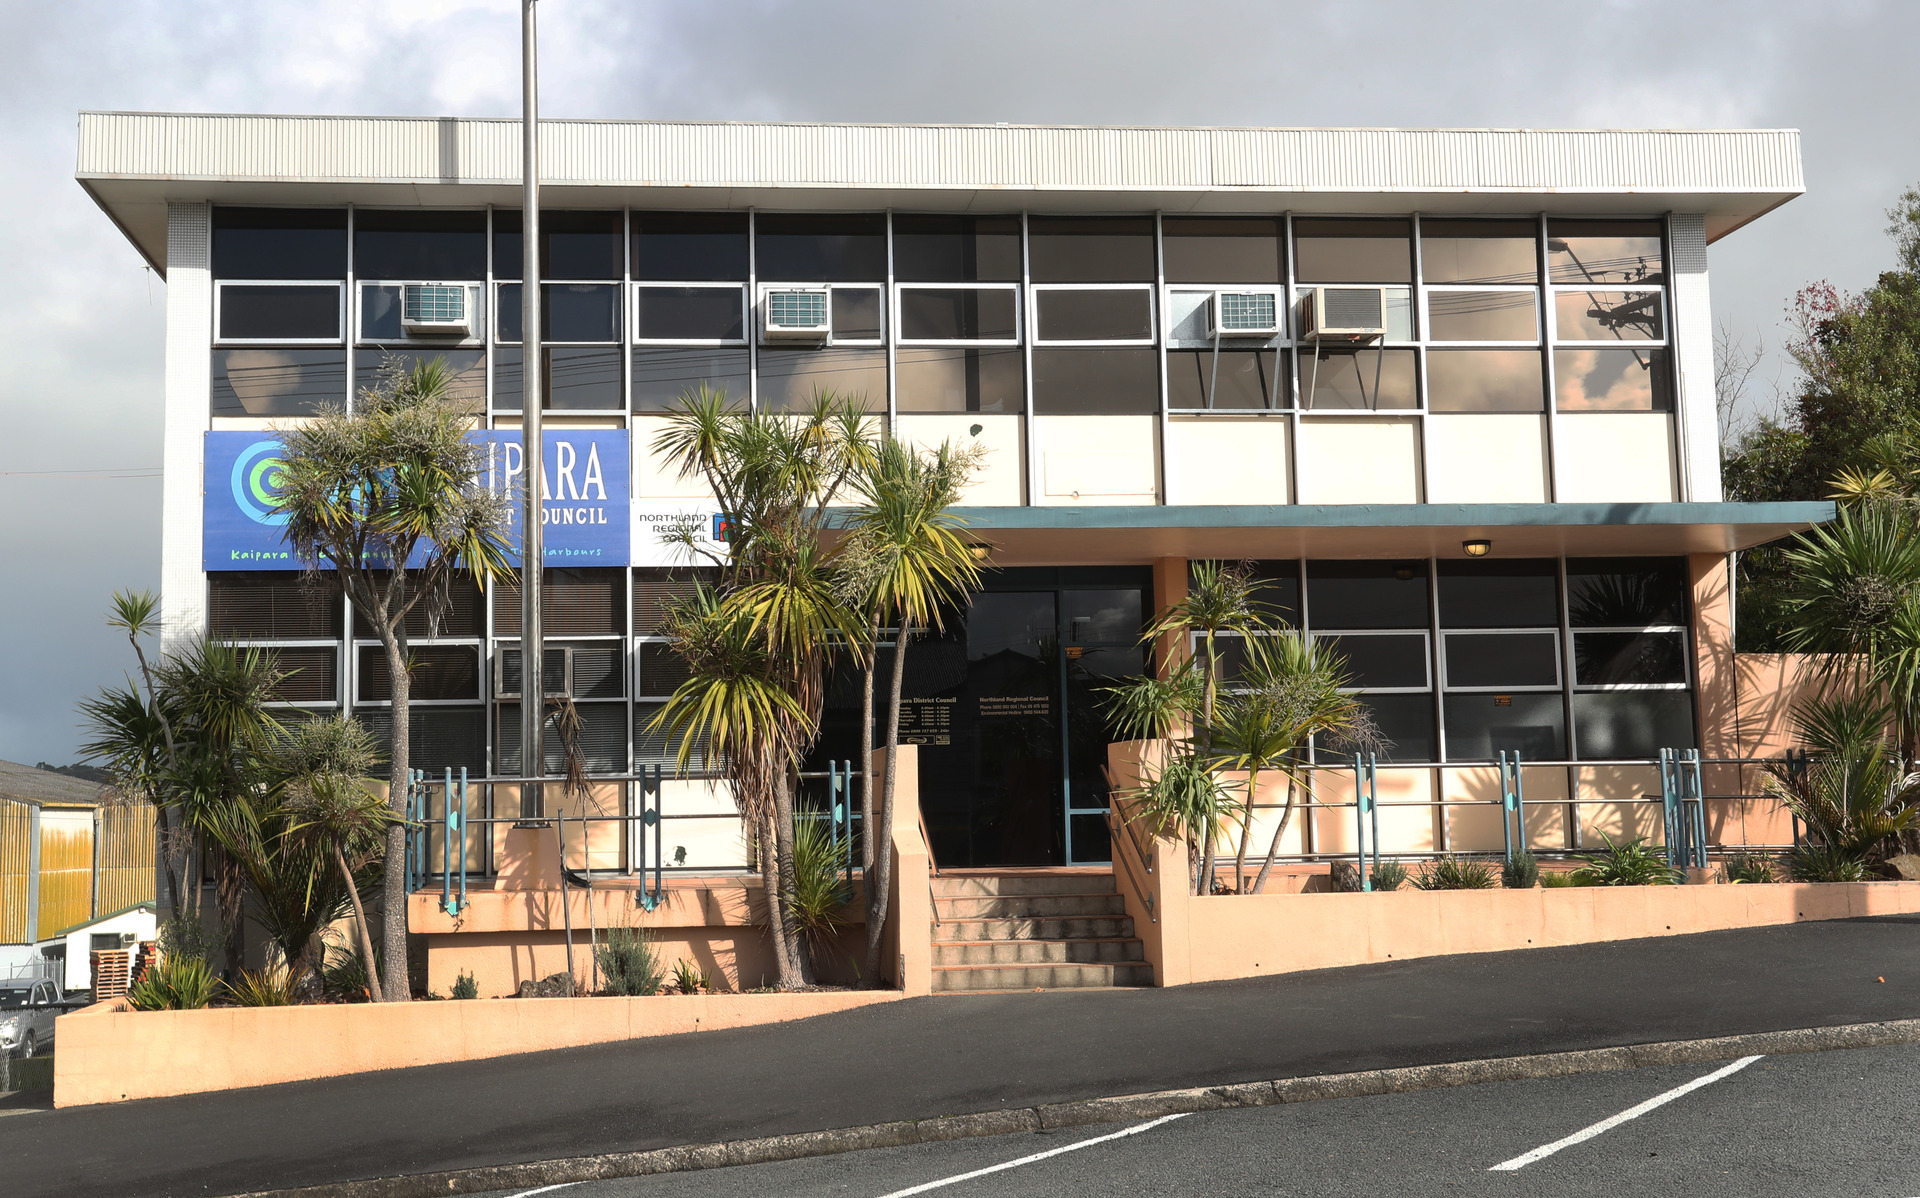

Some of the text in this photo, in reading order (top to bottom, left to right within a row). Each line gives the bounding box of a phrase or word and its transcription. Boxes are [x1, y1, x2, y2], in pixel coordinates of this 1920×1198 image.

[540, 507, 608, 525] OUNCIL
[639, 514, 707, 522] NORTHLAND
[231, 549, 289, 562] Kaipara
